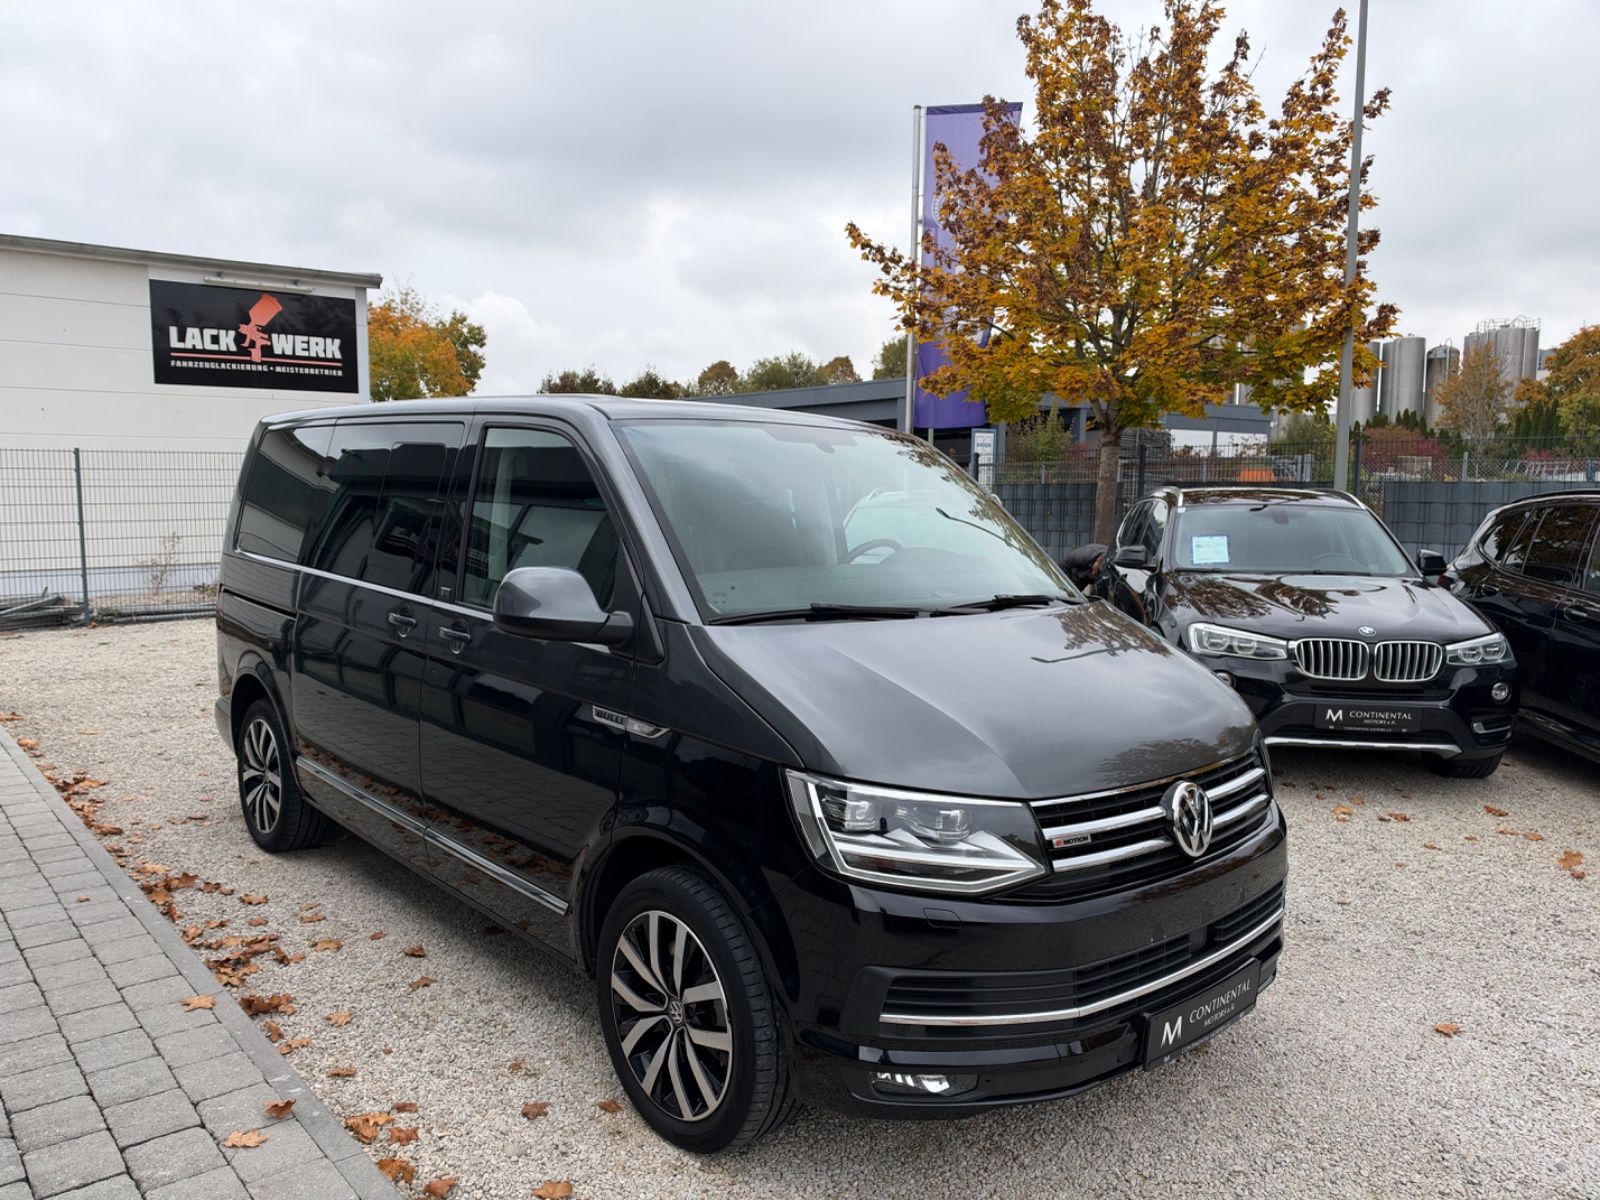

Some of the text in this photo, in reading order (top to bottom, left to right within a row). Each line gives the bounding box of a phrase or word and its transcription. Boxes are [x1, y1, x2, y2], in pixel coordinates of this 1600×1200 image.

[169, 326, 342, 359] LACK WERK
[170, 360, 343, 376] FAHRZEUGLACKIERUNG MEISTERBETRIEB
[1325, 708, 1343, 722] M
[1349, 710, 1413, 720] CONTINENTAL
[1189, 978, 1250, 1024] CONTINENTAL
[1161, 1016, 1182, 1048] M
